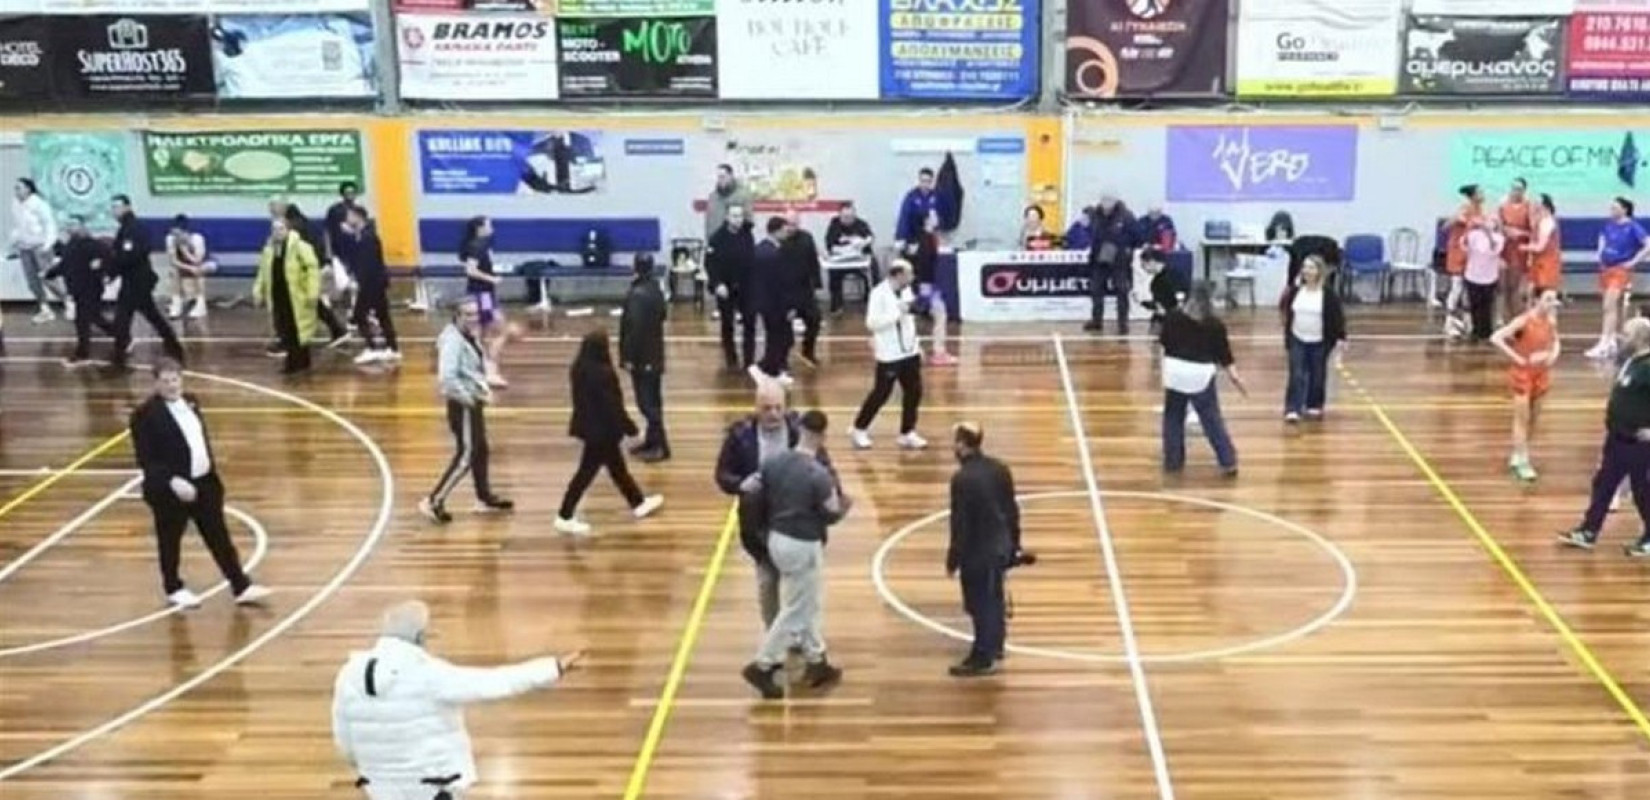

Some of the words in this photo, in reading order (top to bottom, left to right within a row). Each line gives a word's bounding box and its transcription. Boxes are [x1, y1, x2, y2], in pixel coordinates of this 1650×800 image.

[433, 21, 548, 40] BRAMOS
[623, 20, 692, 62] MOTO
[1276, 32, 1305, 50] Go
[563, 51, 621, 62] SCOOTER
[147, 133, 303, 147] ΗΛΕΚΤΡΟΛΟΓΙΚΑ
[308, 133, 355, 146] ΕΡΓΑ
[1472, 145, 1547, 168] PEACE
[1551, 145, 1585, 168] OF
